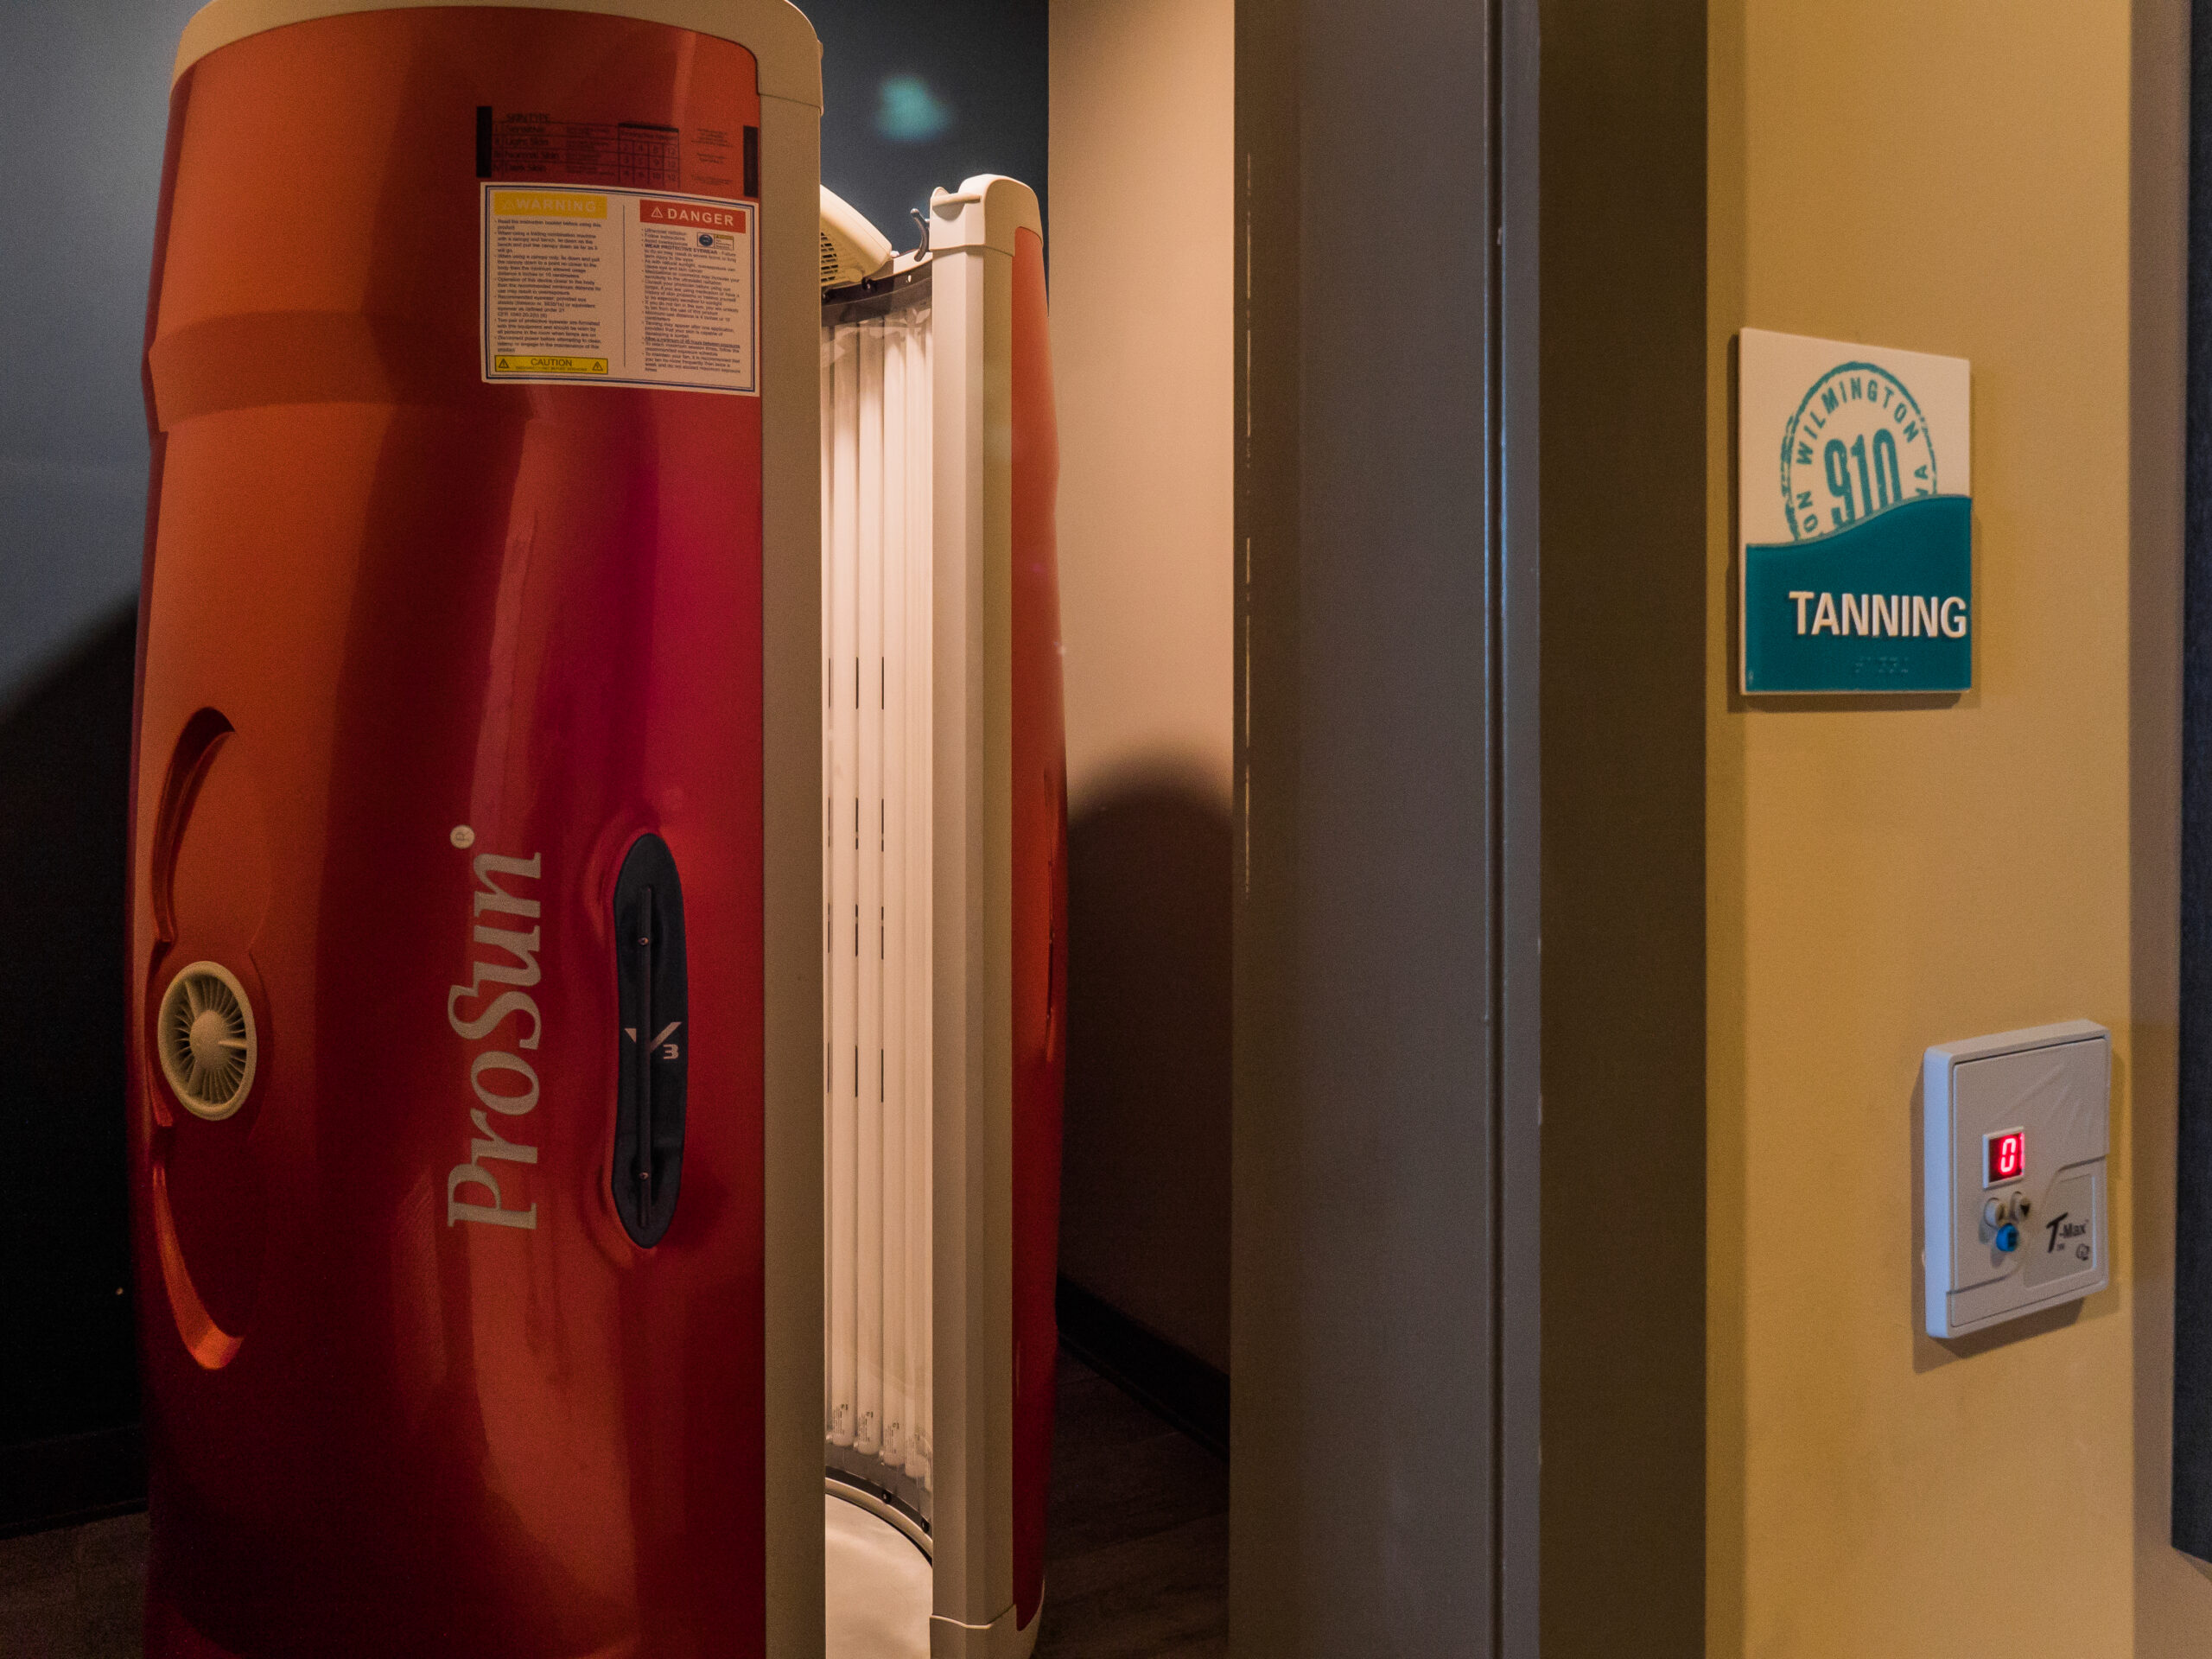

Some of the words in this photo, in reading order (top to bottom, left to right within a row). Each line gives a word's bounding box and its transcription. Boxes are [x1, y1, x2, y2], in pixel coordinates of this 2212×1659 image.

[517, 198, 596, 213] WARNING
[667, 207, 734, 226] DANGER
[1795, 377, 1920, 466] WILMINGTON
[1823, 428, 1903, 529] 910
[1789, 590, 1967, 639] TANNING
[447, 851, 542, 1230] ProSun
[1999, 1138, 2017, 1173] 0
[2046, 1212, 2086, 1253] T-Max
